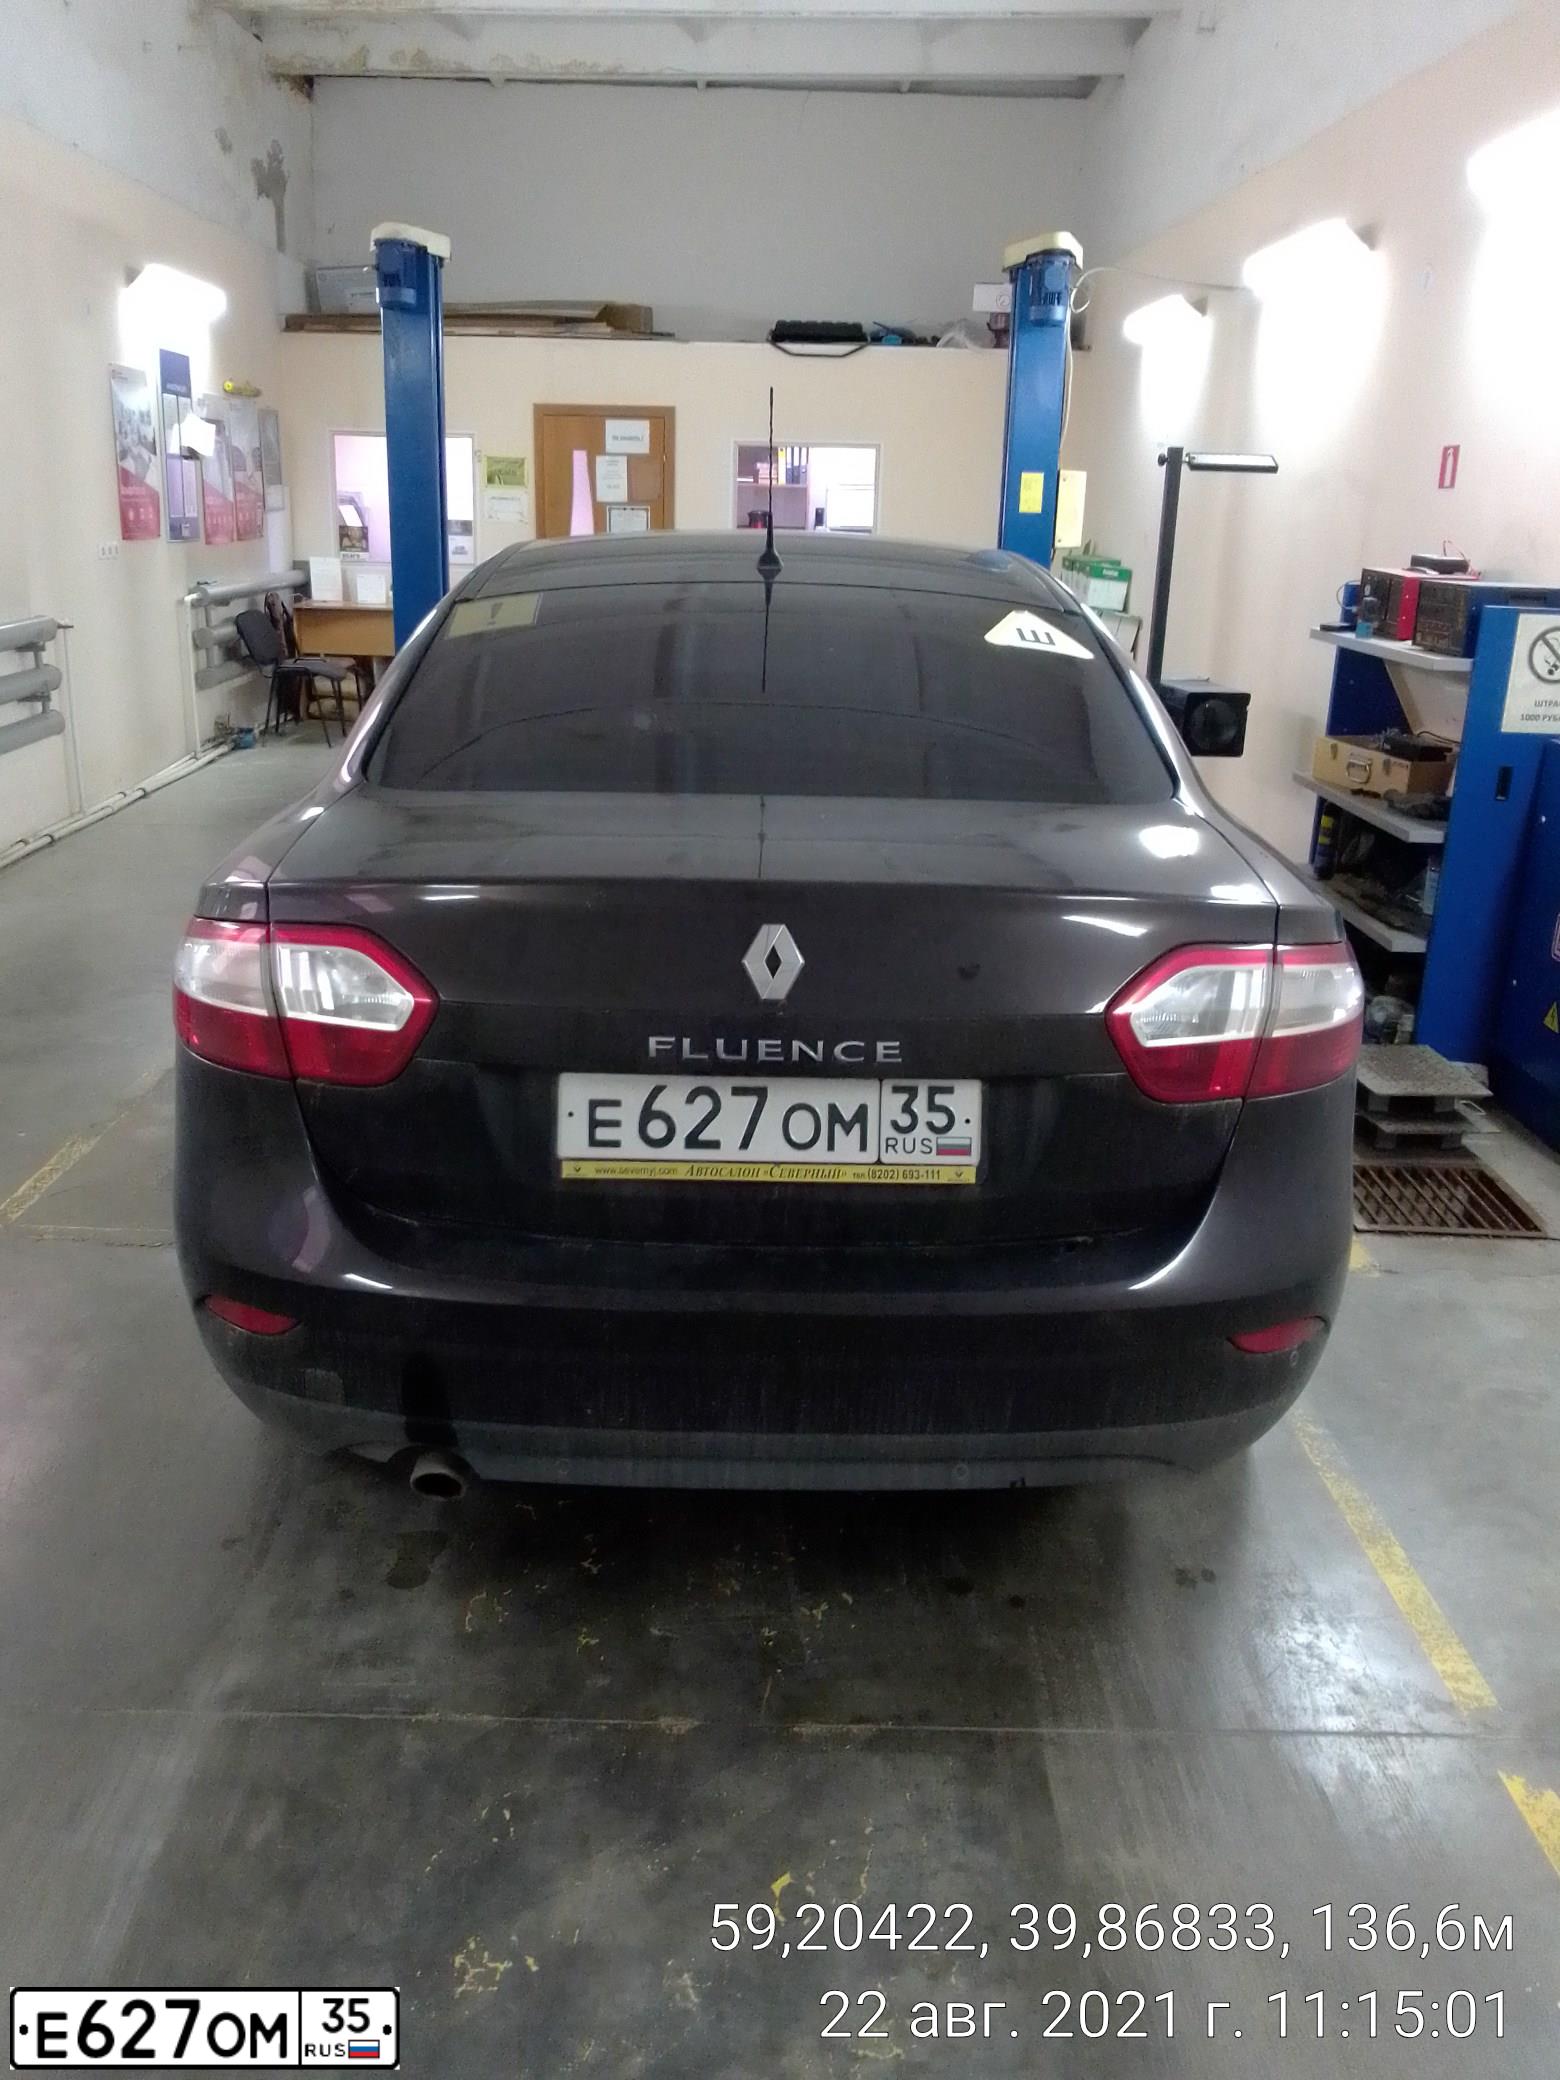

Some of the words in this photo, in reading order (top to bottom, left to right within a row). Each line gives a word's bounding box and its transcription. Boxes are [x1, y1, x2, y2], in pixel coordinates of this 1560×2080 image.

[1534, 699, 1560, 708] ШТРА
[1520, 713, 1541, 722] 1000
[1542, 713, 1560, 722] РУБ
[648, 1035, 902, 1063] FLUENCE
[890, 1085, 956, 1135] 35
[885, 1137, 933, 1155] RUS
[867, 1168, 900, 1181] (8202)
[902, 1169, 941, 1181] 693-111
